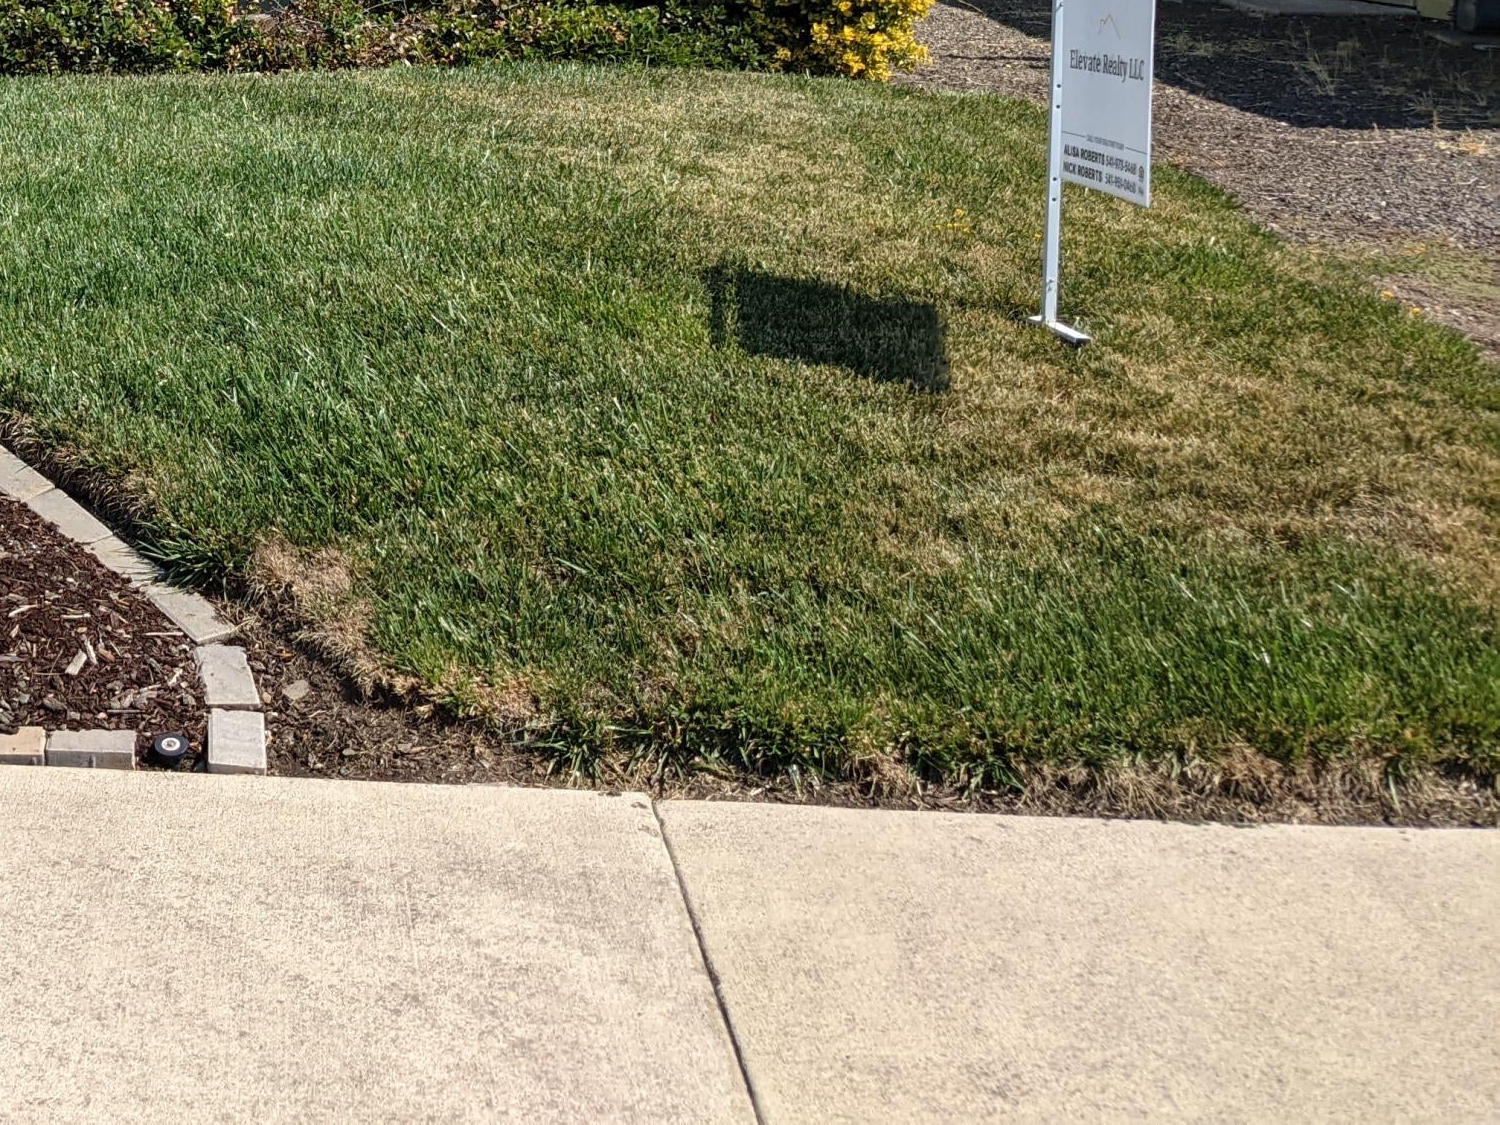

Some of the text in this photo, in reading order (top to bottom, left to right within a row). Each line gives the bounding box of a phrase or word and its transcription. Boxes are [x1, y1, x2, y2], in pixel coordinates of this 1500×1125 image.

[1069, 49, 1145, 83] Elevate Realty LLC
[1063, 144, 1080, 158] ALISA
[1080, 148, 1105, 166] ROBERTS
[1062, 161, 1077, 175] NICK
[1077, 165, 1103, 183] ROBERTS
